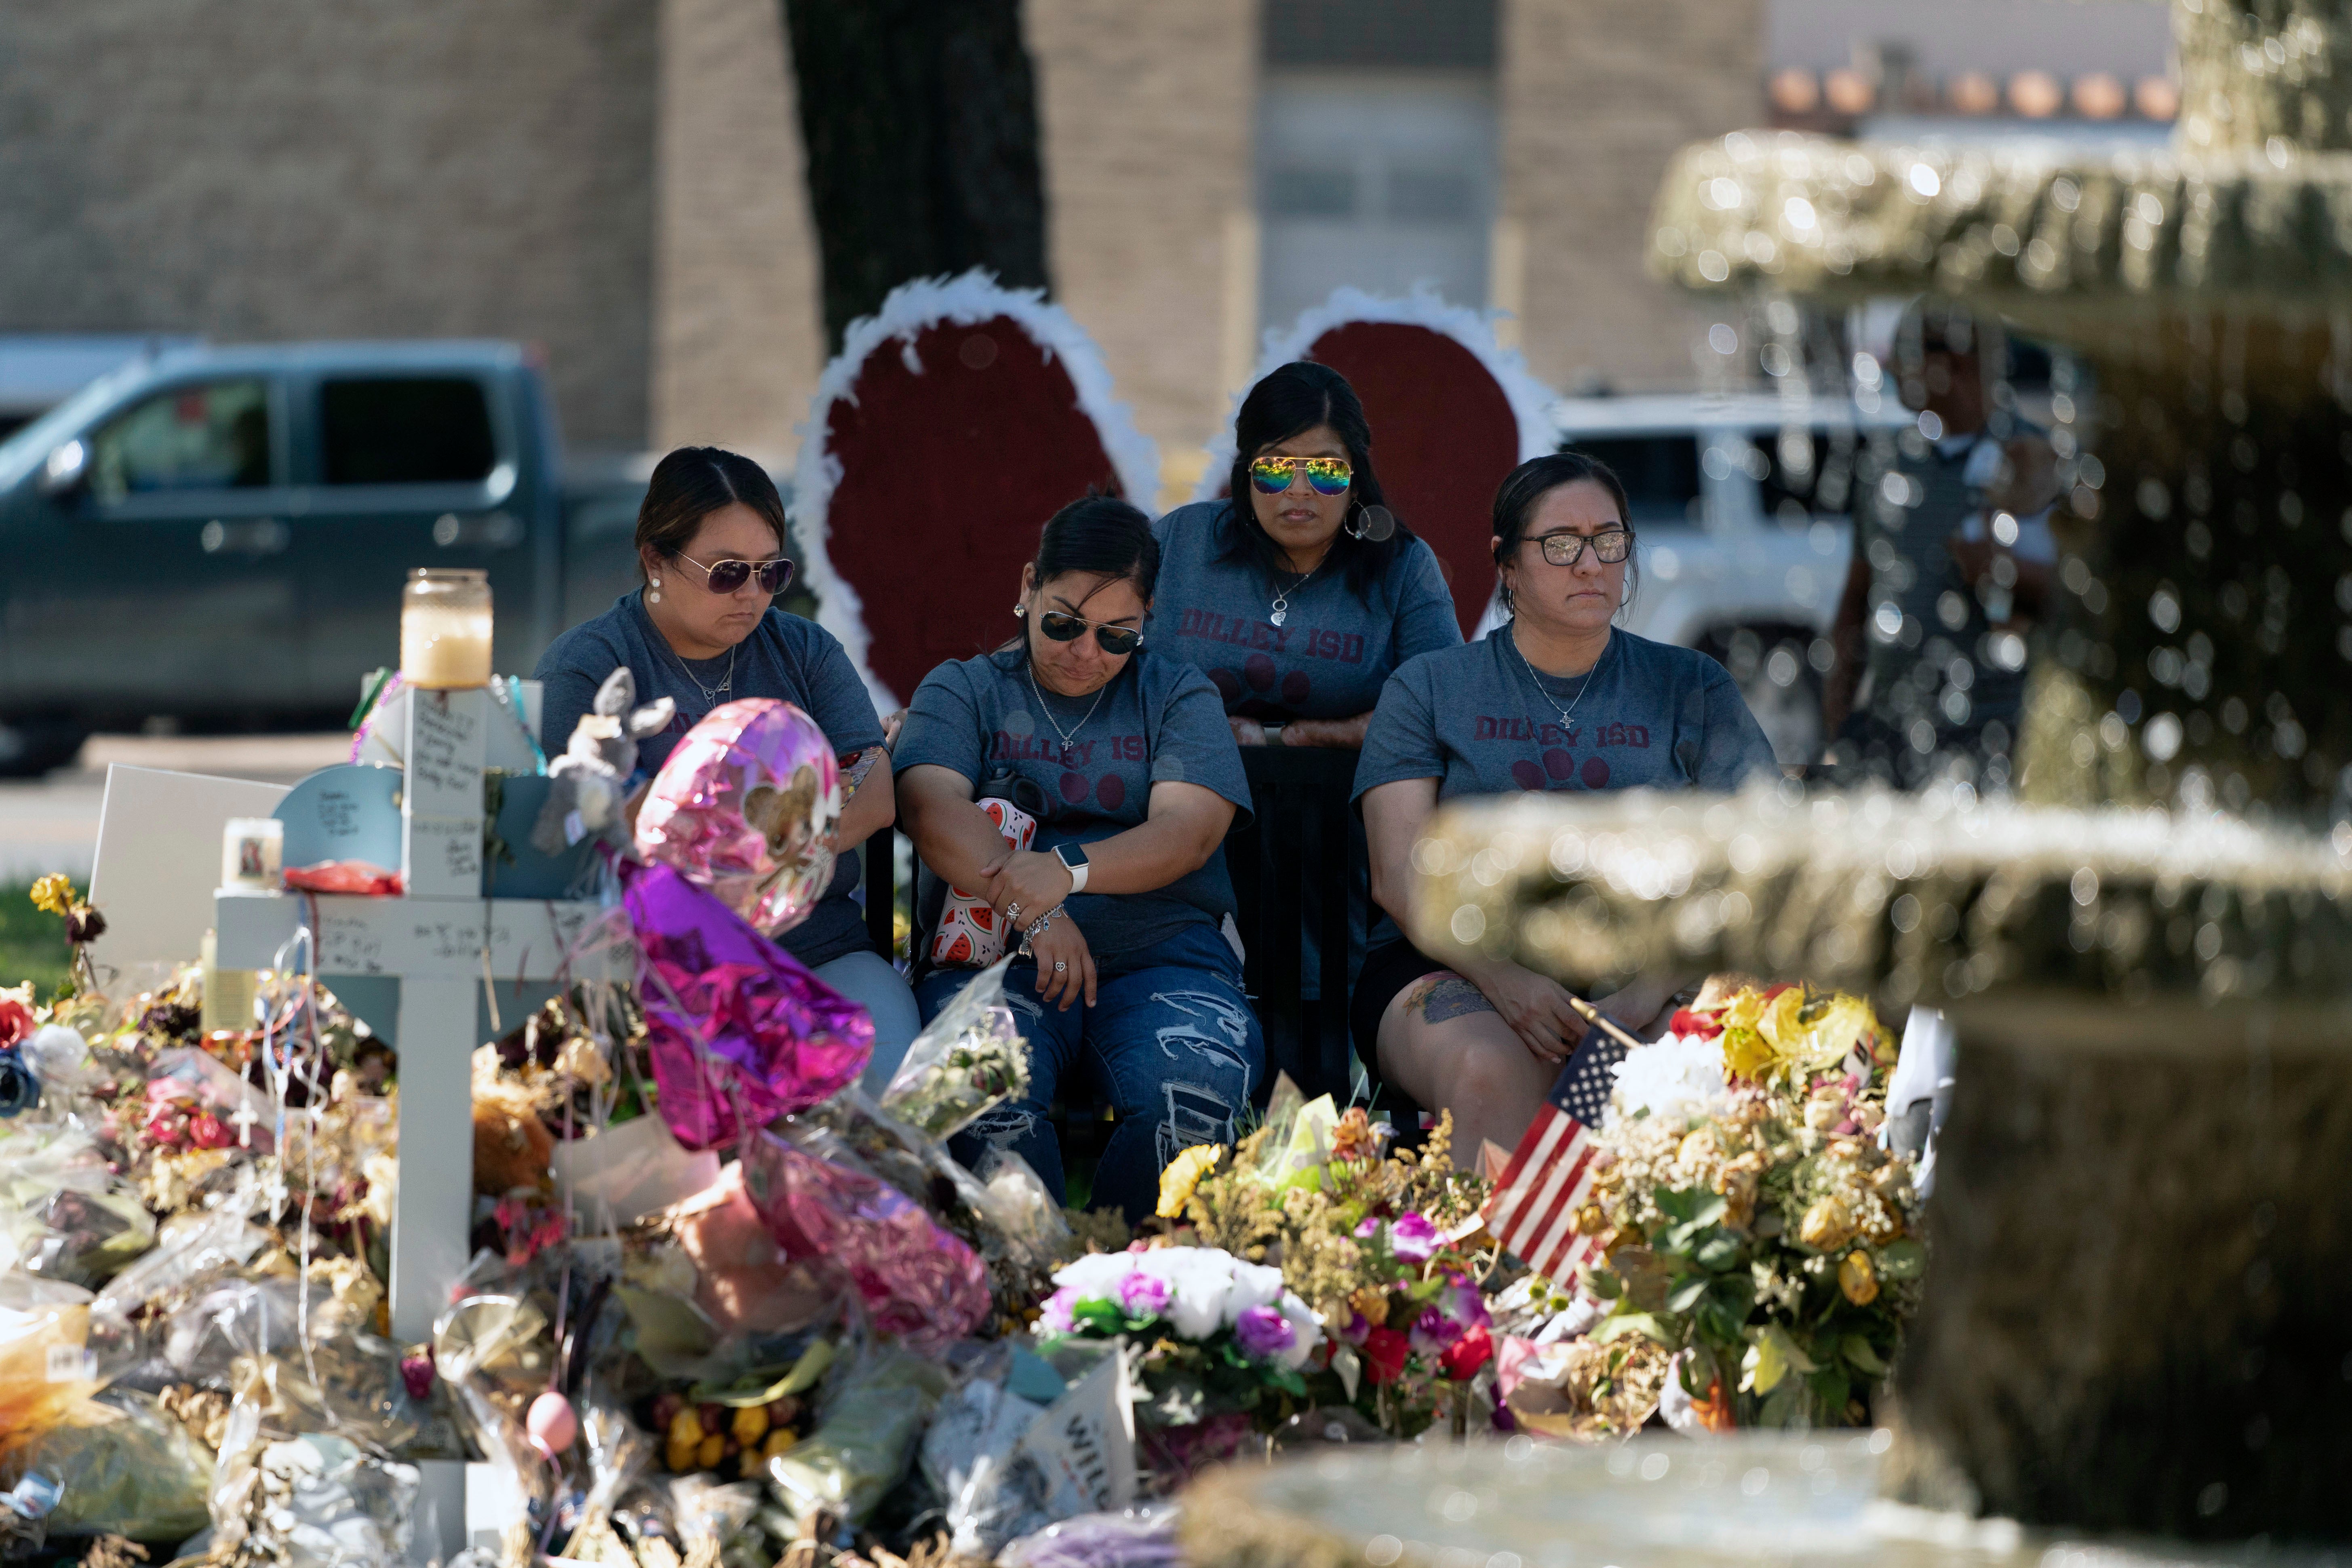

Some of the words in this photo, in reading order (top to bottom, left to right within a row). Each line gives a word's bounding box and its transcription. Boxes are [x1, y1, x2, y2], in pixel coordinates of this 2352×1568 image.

[1176, 609, 1296, 652] DILLEY
[1306, 629, 1364, 664] ISD
[989, 730, 1097, 770] DILLEY
[1111, 735, 1150, 763] IS
[1473, 715, 1582, 748] DILLEY
[1596, 721, 1650, 749] ISD
